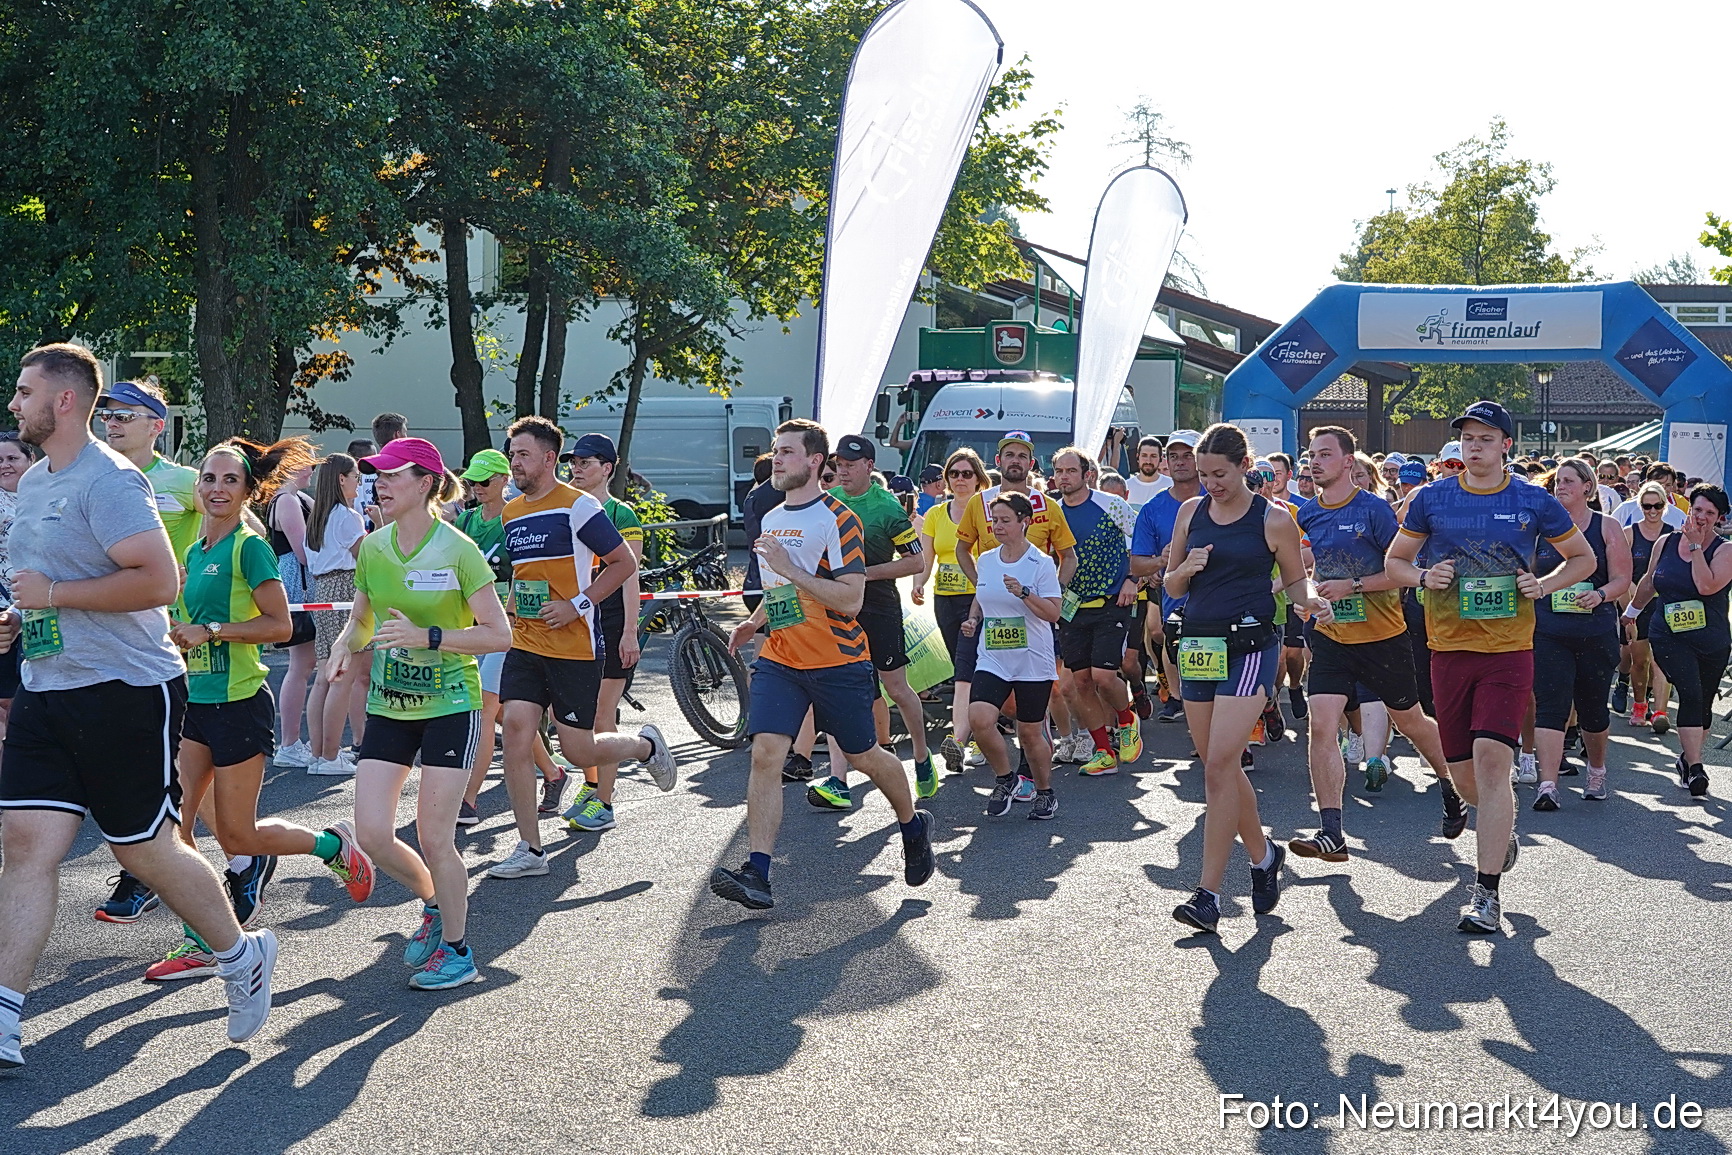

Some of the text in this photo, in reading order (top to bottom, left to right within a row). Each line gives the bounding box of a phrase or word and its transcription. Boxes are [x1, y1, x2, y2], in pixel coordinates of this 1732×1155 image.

[1475, 303, 1505, 313] Fischer
[1452, 321, 1542, 338] firmenlauf
[1279, 346, 1326, 359] Fischer
[1630, 351, 1644, 360] und
[1645, 349, 1658, 357] das
[933, 408, 973, 418] abavent
[1006, 412, 1064, 421] DATASPORT
[1400, 470, 1421, 478] adidas
[510, 533, 549, 547] Fischer
[771, 529, 805, 538] KLEBL
[513, 543, 544, 552] AUTOMOBILE
[942, 572, 959, 583] 554
[518, 594, 542, 607] 1821
[1474, 591, 1503, 606] 648
[768, 601, 790, 617] 572
[791, 600, 802, 618] 2022
[1673, 610, 1695, 622] 830
[26, 619, 45, 640] 647
[50, 619, 60, 646] 2022
[991, 628, 1020, 640] 1488
[1188, 651, 1214, 667] 487
[393, 660, 433, 682] 1320
[434, 667, 442, 689] 2022
